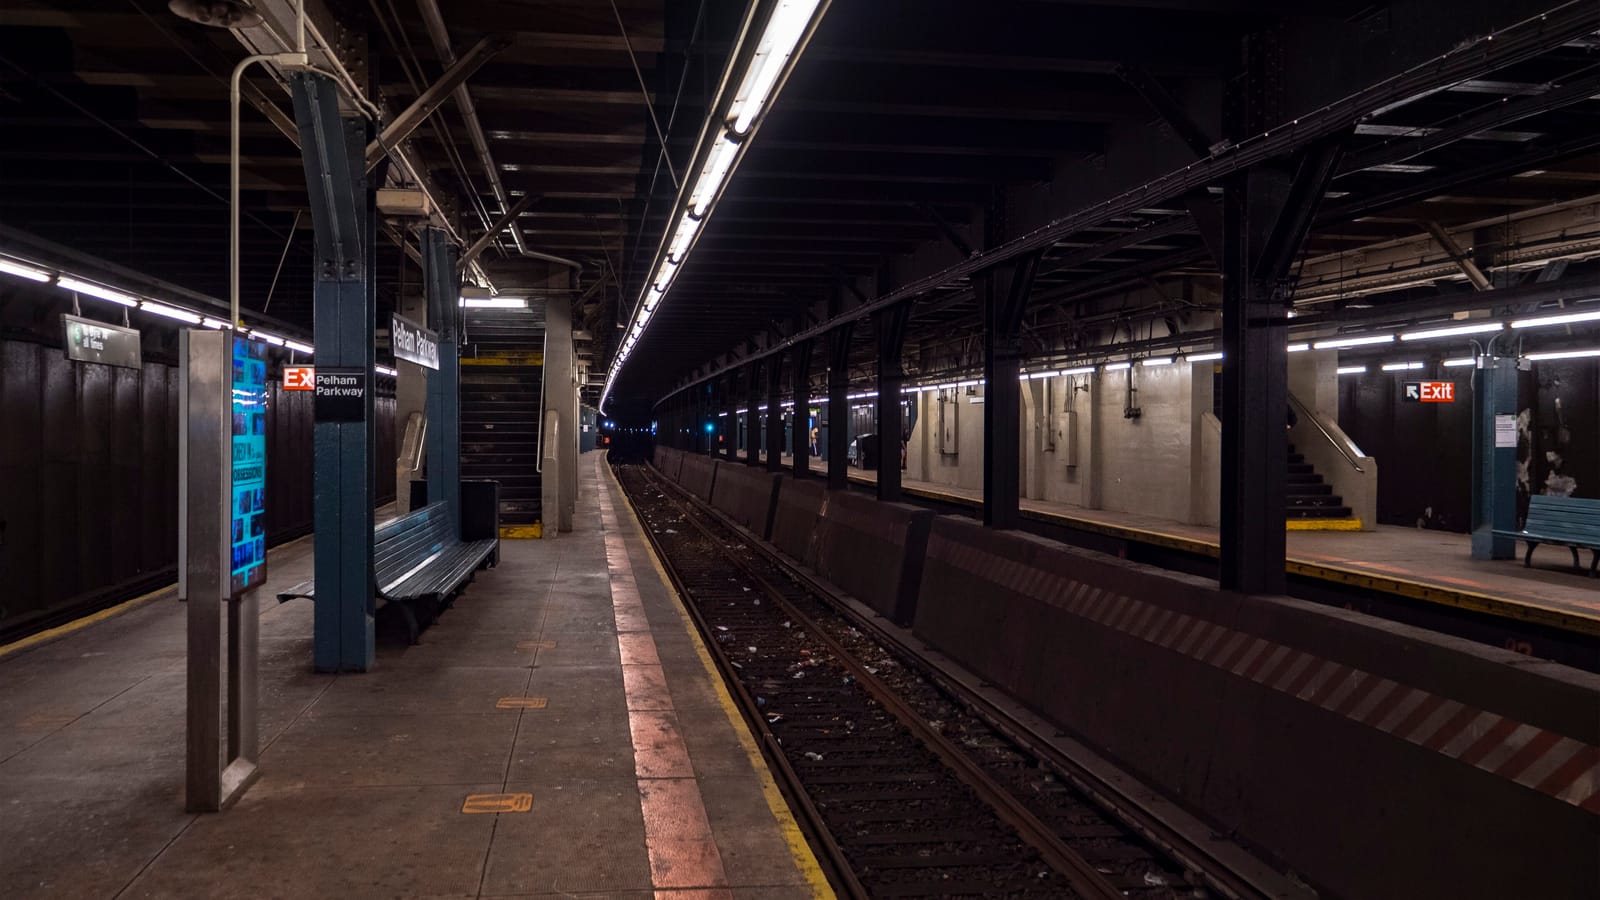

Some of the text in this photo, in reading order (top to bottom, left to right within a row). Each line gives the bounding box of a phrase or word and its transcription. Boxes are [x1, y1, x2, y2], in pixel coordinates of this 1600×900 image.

[283, 368, 315, 387] Ex
[316, 375, 357, 385] Pelham
[316, 387, 364, 398] Parkway
[1420, 382, 1452, 399] Exit
